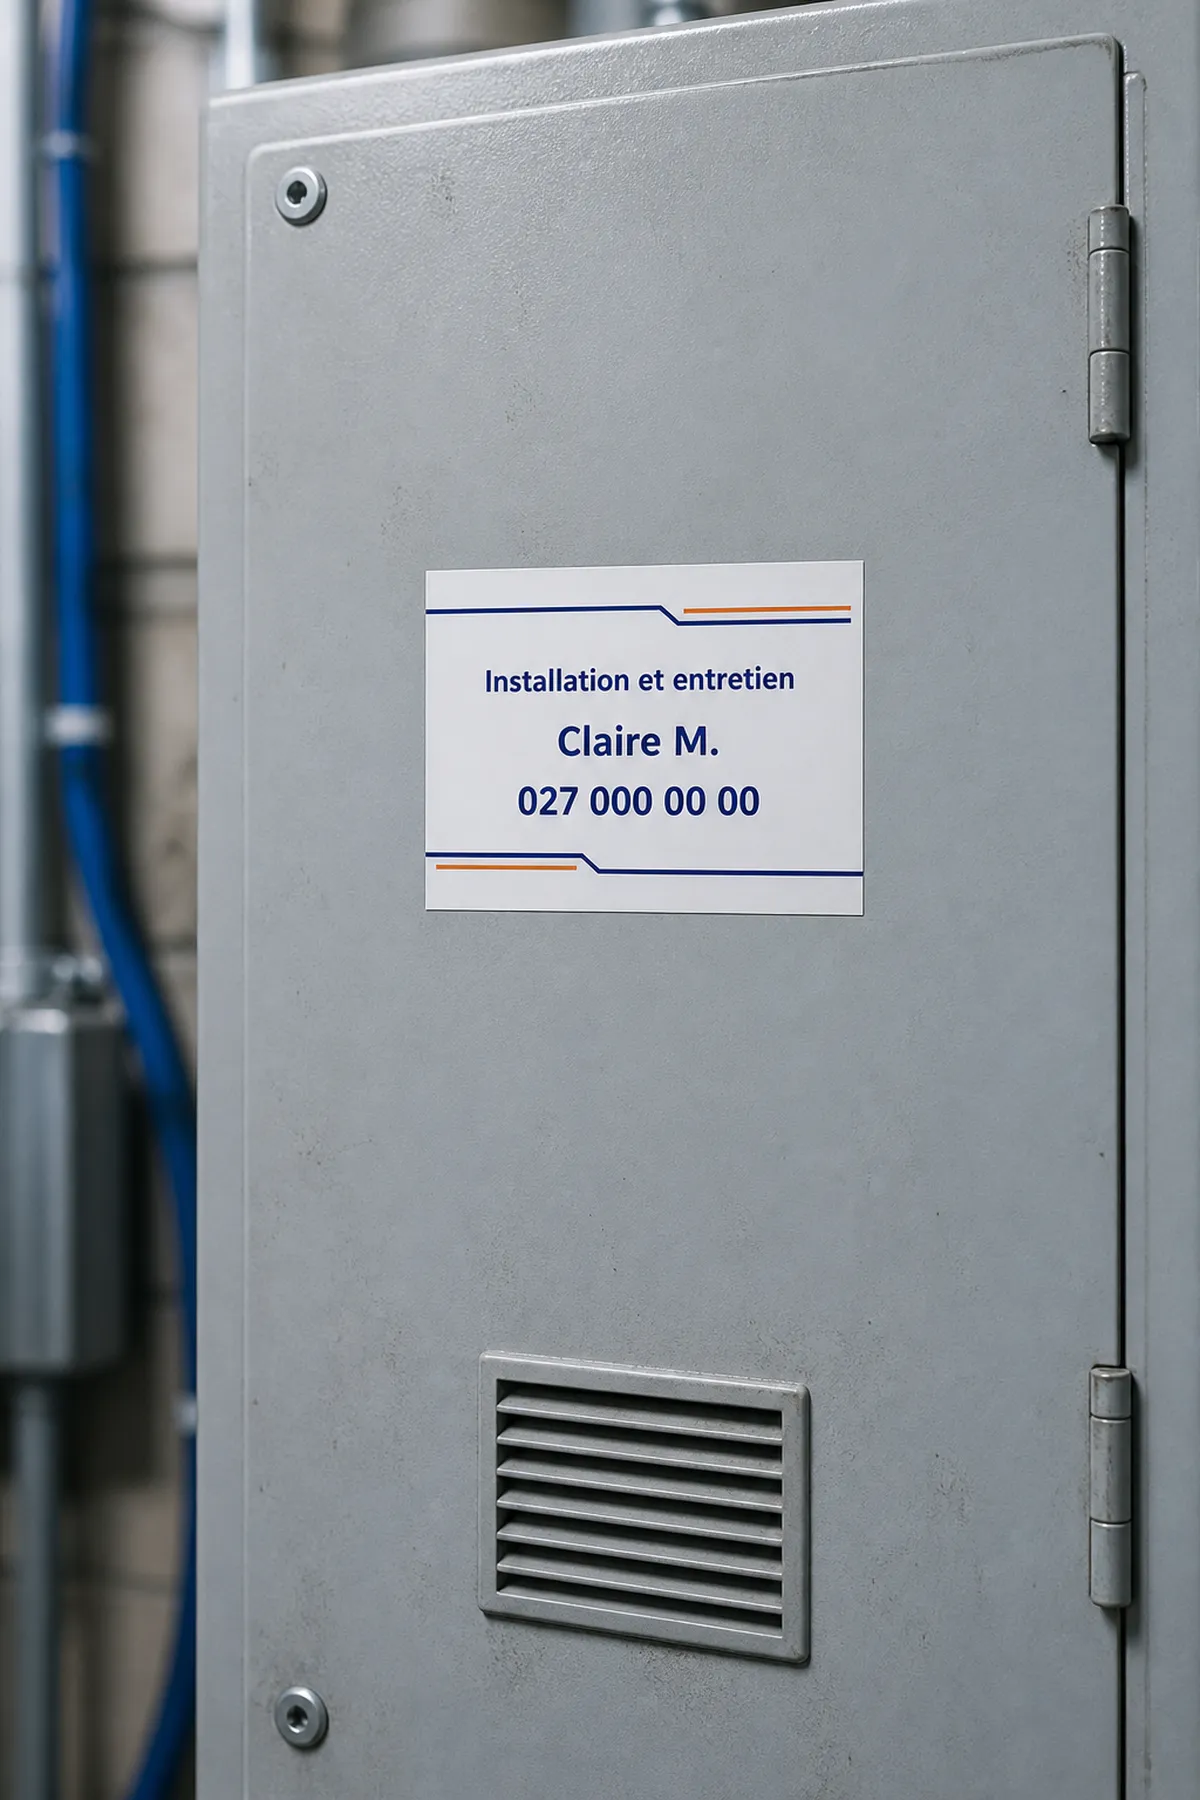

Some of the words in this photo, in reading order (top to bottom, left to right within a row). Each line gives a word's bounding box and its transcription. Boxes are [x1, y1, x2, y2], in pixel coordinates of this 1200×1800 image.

[485, 668, 630, 693] Installation
[638, 669, 665, 692] et
[672, 666, 795, 691] entretien
[557, 724, 661, 757] Claire
[675, 725, 719, 757] M.
[518, 785, 579, 816] 027
[589, 785, 653, 816] 000
[664, 785, 706, 816] 00
[717, 785, 760, 816] 00
